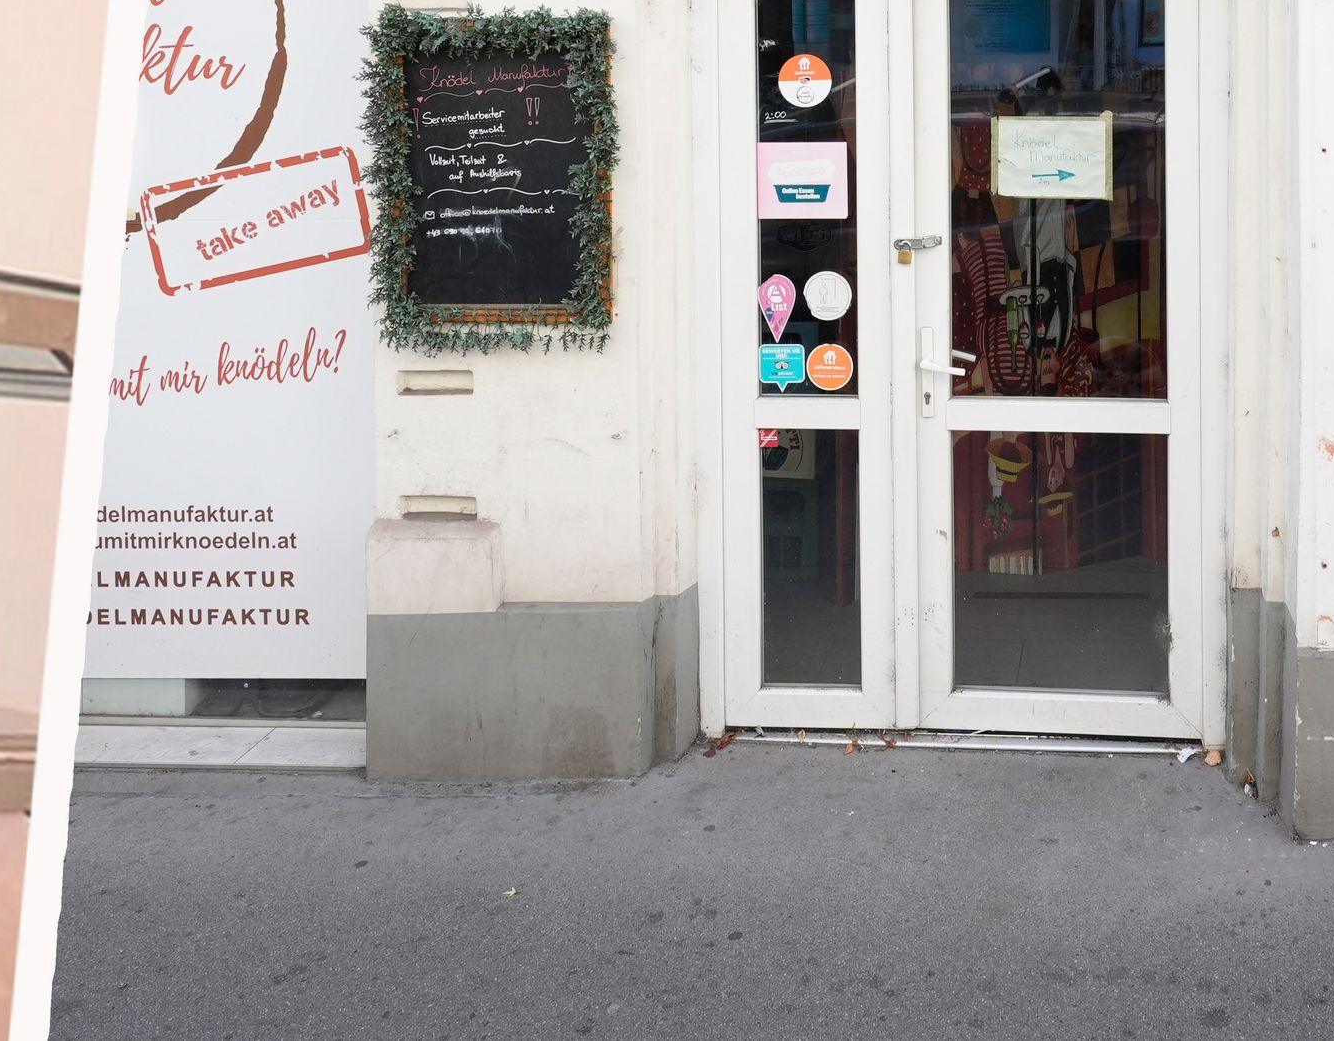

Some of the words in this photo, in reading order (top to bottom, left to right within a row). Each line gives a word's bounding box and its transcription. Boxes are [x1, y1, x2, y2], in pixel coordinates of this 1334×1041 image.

[418, 65, 476, 91] Knödel
[488, 63, 567, 87] Manufaktur
[422, 107, 505, 125] Servicemitarbeiter
[449, 170, 464, 184] auf
[196, 220, 258, 261] take
[267, 179, 340, 228] away
[160, 361, 207, 394] mir
[217, 326, 347, 386] knödeln?
[91, 571, 295, 588] LMANUFAKTUR
